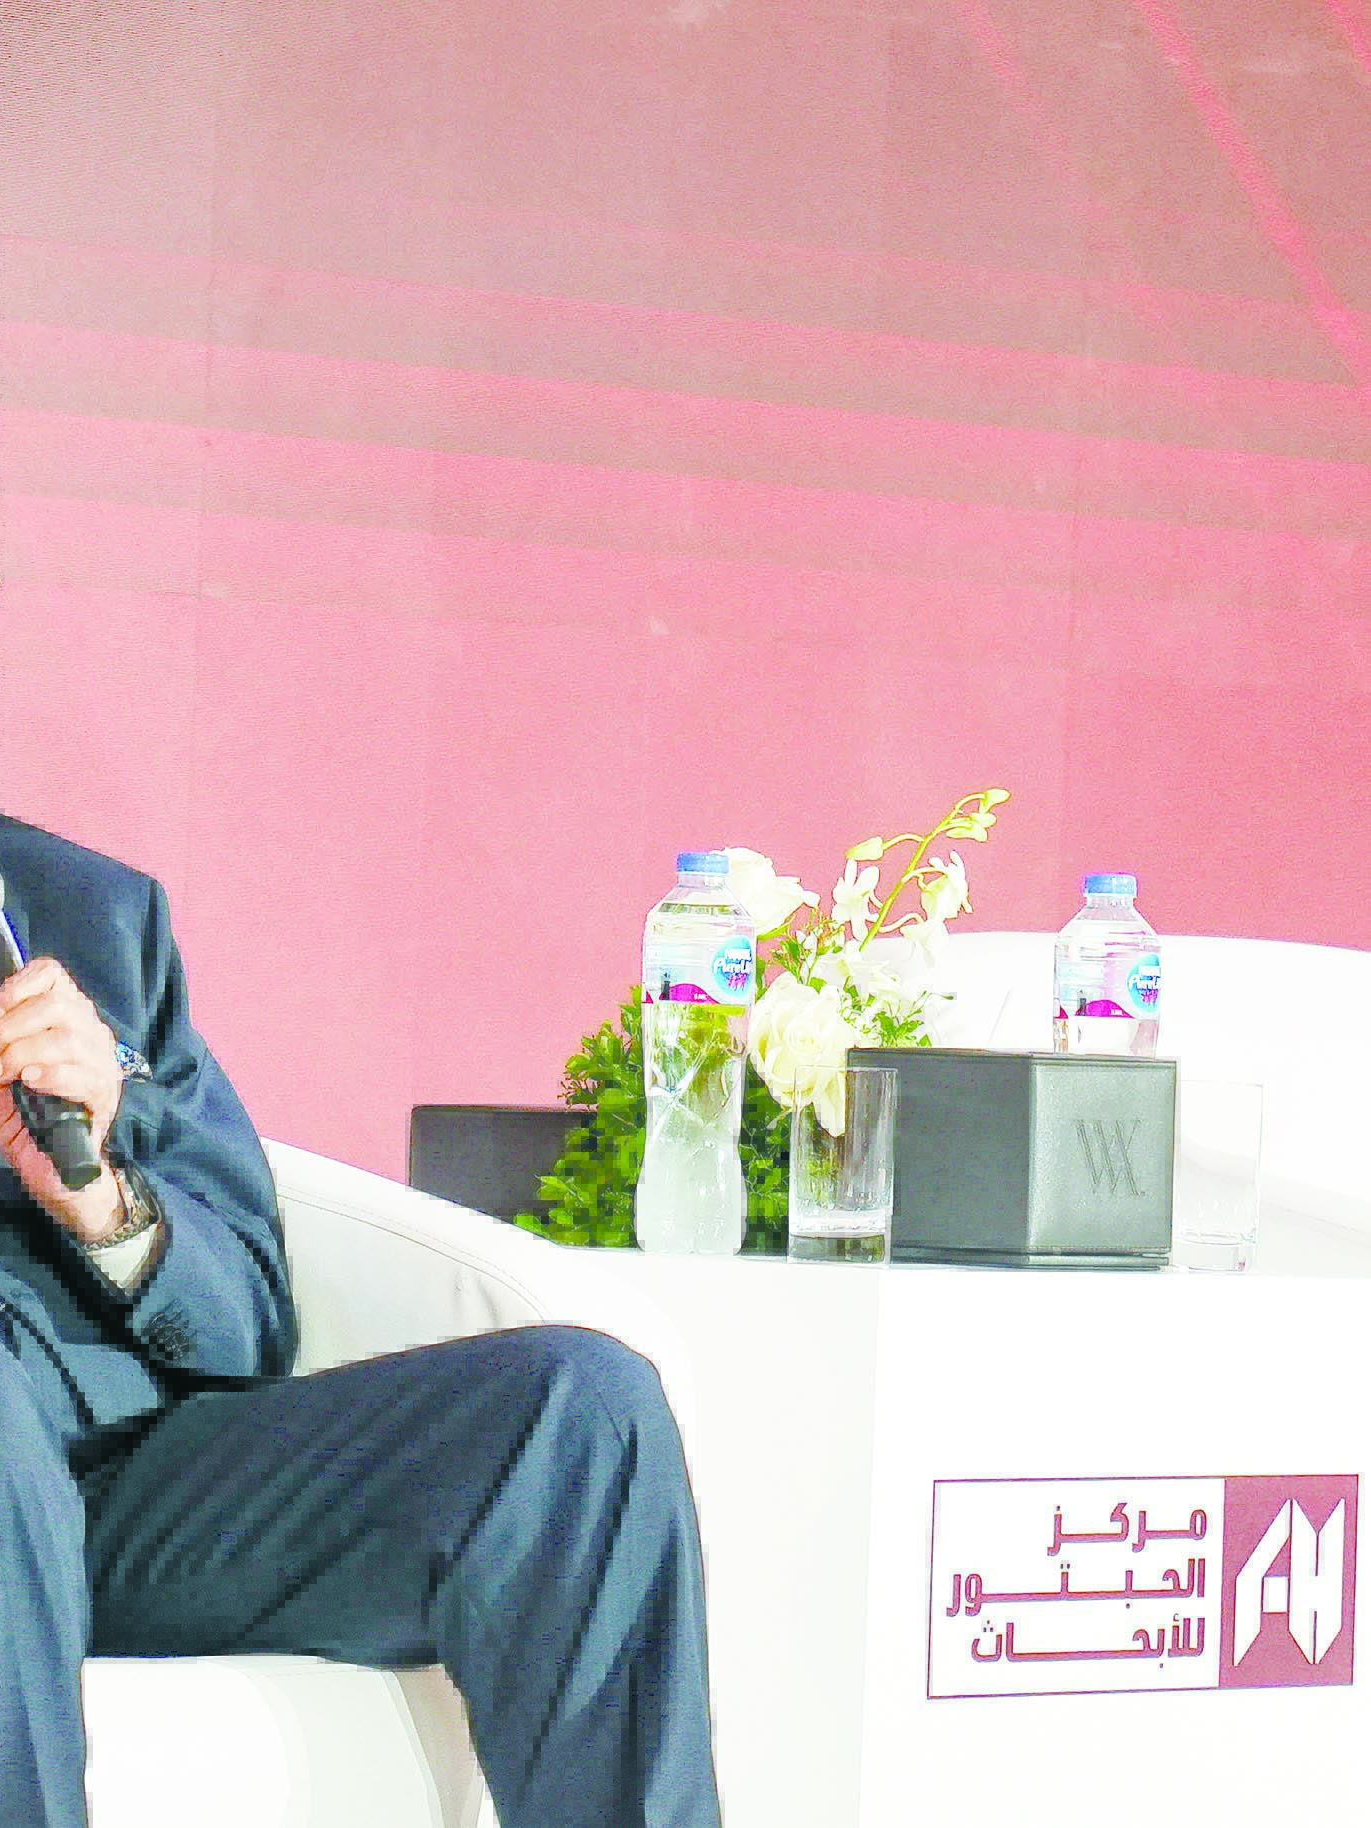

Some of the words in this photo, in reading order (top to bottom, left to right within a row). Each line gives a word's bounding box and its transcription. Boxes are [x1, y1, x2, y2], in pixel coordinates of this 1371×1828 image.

[1047, 1501, 1208, 1557] مركز
[946, 1557, 1207, 1618] الحبتور
[971, 1613, 1207, 1669] للأبحاث
